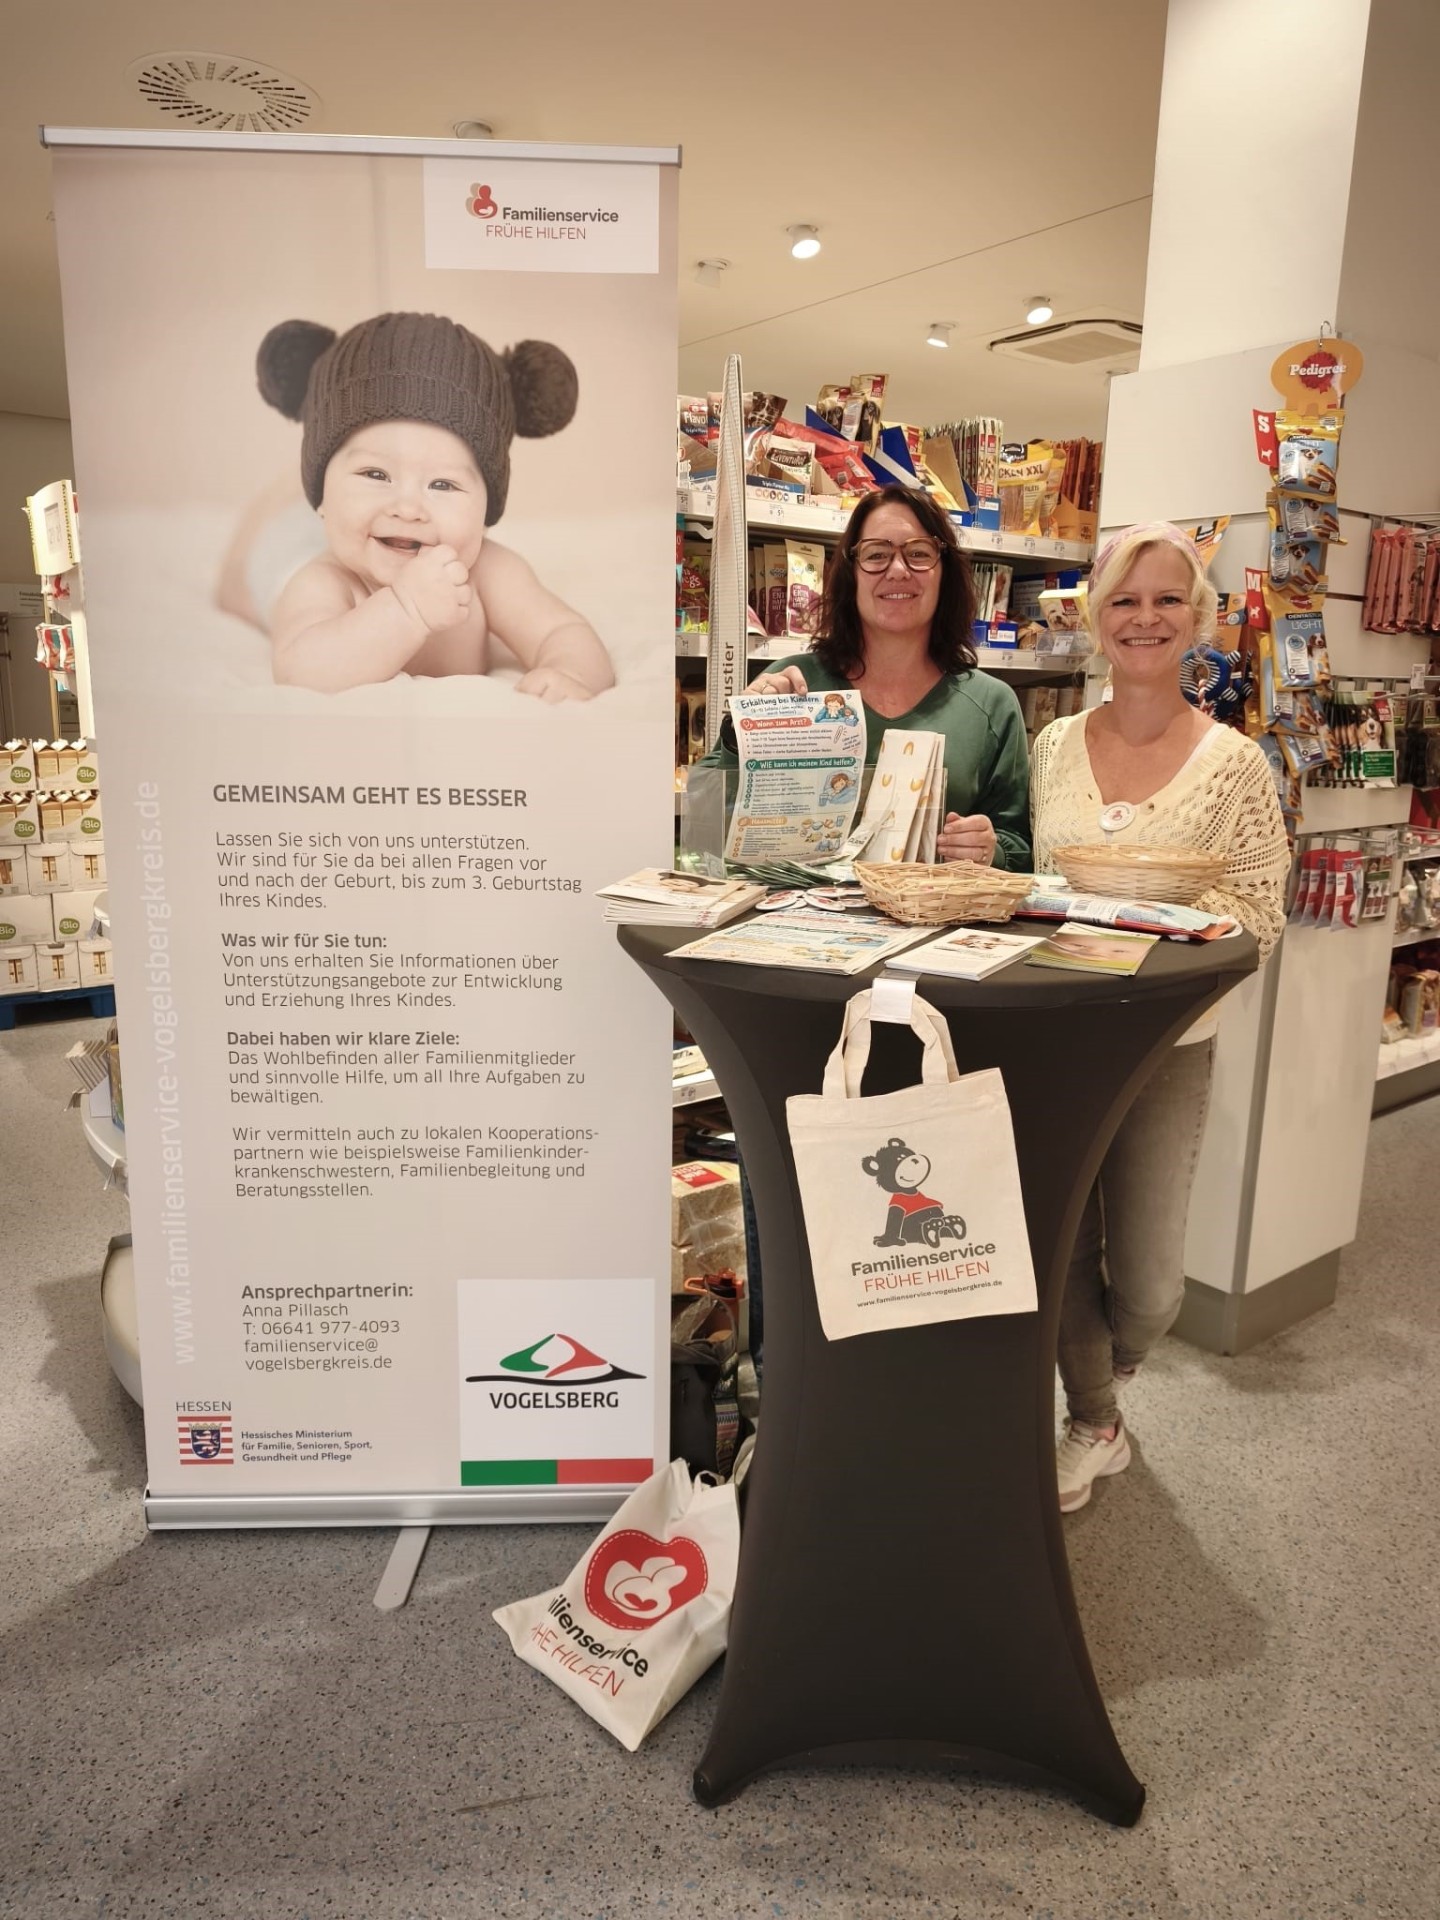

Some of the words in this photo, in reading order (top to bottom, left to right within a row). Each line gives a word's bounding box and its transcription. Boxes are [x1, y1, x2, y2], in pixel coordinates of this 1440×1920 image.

[503, 206, 619, 222] Familienservice
[486, 222, 533, 240] FRÜHE
[536, 226, 586, 240] HILFEN
[684, 412, 708, 424] Flavo
[1258, 416, 1269, 433] S
[1026, 464, 1044, 476] XXL
[1247, 572, 1261, 592] M
[740, 697, 777, 709] Erkältung
[778, 696, 790, 704] bei
[790, 695, 820, 704] Kindern
[790, 718, 808, 726] Arzt?
[760, 761, 772, 769] WIE
[788, 760, 797, 768] ich
[833, 758, 854, 766] helfen?
[212, 783, 346, 805] GEMEINSAM
[352, 785, 411, 805] GEHT
[416, 786, 442, 806] ES
[448, 787, 528, 808] BESSER
[215, 831, 273, 847] Lassen
[277, 831, 303, 848] Sie
[308, 831, 342, 848] sich
[347, 835, 380, 848] von
[385, 835, 415, 849] uns
[420, 833, 530, 851] unterstützen.
[216, 851, 247, 868] Wir
[252, 851, 287, 868] sind
[292, 852, 318, 868] für
[323, 852, 351, 869] Sie
[353, 852, 375, 869] da
[380, 852, 406, 869] bei
[411, 853, 452, 869] allen
[458, 854, 514, 873] Fragen
[519, 858, 548, 871] vor
[217, 871, 250, 888] und
[255, 872, 295, 888] nach
[300, 872, 329, 889] der
[333, 872, 396, 891] Geburt,
[401, 873, 426, 889] bis
[431, 876, 466, 890] zum
[471, 874, 487, 890] 3.
[492, 874, 583, 894] Geburtstag
[219, 891, 261, 908] Ihres
[266, 892, 327, 909] Kindes.
[220, 932, 257, 949] Was
[260, 932, 290, 948] wir
[293, 932, 320, 949] für
[323, 932, 350, 949] Sie
[353, 933, 388, 949] tun:
[219, 951, 256, 969] Von
[259, 955, 289, 969] uns
[293, 952, 364, 969] erhalten
[368, 952, 395, 969] Sie
[400, 952, 517, 970] Informationen
[521, 954, 560, 971] über
[223, 972, 426, 991] Unterstützungsangebote
[431, 975, 459, 988] zur
[464, 973, 563, 992] Entwicklung
[224, 990, 256, 1009] und
[261, 991, 345, 1010] Erziehung
[350, 992, 391, 1008] Ihres
[396, 991, 457, 1007] Kindes.
[225, 1030, 275, 1047] Dabei
[278, 1030, 331, 1047] haben
[334, 1030, 365, 1047] wir
[368, 1030, 411, 1046] klare
[414, 1030, 460, 1046] Ziele:
[227, 1049, 259, 1066] Das
[262, 1049, 378, 1066] Wohlbefinden
[383, 1049, 421, 1065] aller
[425, 1049, 577, 1068] Familienmitglieder
[135, 780, 195, 1366] www.familienservice-vogelsbergkreis.de
[226, 1068, 260, 1088] und
[264, 1069, 340, 1086] sinnvolle
[345, 1068, 388, 1086] Hilfe,
[392, 1071, 419, 1084] um
[423, 1068, 443, 1084] all
[449, 1068, 481, 1084] Ihre
[484, 1068, 562, 1087] Aufgaben
[565, 1071, 585, 1087] zu
[229, 1087, 324, 1106] bewältigen.
[231, 1126, 262, 1143] Wir
[266, 1126, 352, 1142] vermitteln
[356, 1125, 395, 1141] auch
[399, 1128, 420, 1141] zu
[424, 1124, 483, 1141] lokalen
[488, 1125, 600, 1143] Kooperations-
[233, 1146, 304, 1163] partnern
[309, 1145, 339, 1160] wie
[343, 1143, 461, 1162] beispielsweise
[465, 1143, 590, 1160] Familienkinder-
[234, 1163, 395, 1180] krankenschwestern,
[400, 1162, 552, 1180] Familienbegleitung
[555, 1162, 585, 1178] und
[235, 1181, 374, 1200] Beratungsstellen.
[851, 1242, 996, 1276] Familienservice
[864, 1272, 923, 1293] FRÜHE
[927, 1261, 990, 1285] HILFEN
[240, 1281, 414, 1302] Ansprechpartnerin:
[857, 1279, 1003, 1308] www.familienservice-vogelsbergkreis.de
[241, 1304, 283, 1318] Anna
[288, 1302, 349, 1318] Pillasch
[241, 1321, 257, 1336] T:
[261, 1320, 315, 1336] 06641
[319, 1319, 401, 1335] 977-4093
[242, 1337, 379, 1354] familienservice@
[244, 1354, 393, 1373] vogelsbergkreis.de
[175, 1400, 232, 1413] HESSEN
[488, 1390, 620, 1410] VOGELSBERG
[240, 1429, 294, 1440] Hessisches
[294, 1429, 353, 1439] Ministerium
[240, 1441, 256, 1453] für
[256, 1440, 295, 1452] Familie,
[295, 1440, 343, 1451] Senioren,
[343, 1440, 373, 1452] Sport,
[239, 1450, 300, 1463] Gesundheit
[299, 1451, 319, 1462] und
[320, 1450, 353, 1463] Pflege
[532, 1622, 558, 1653] HE
[552, 1642, 625, 1697] HILFEN
